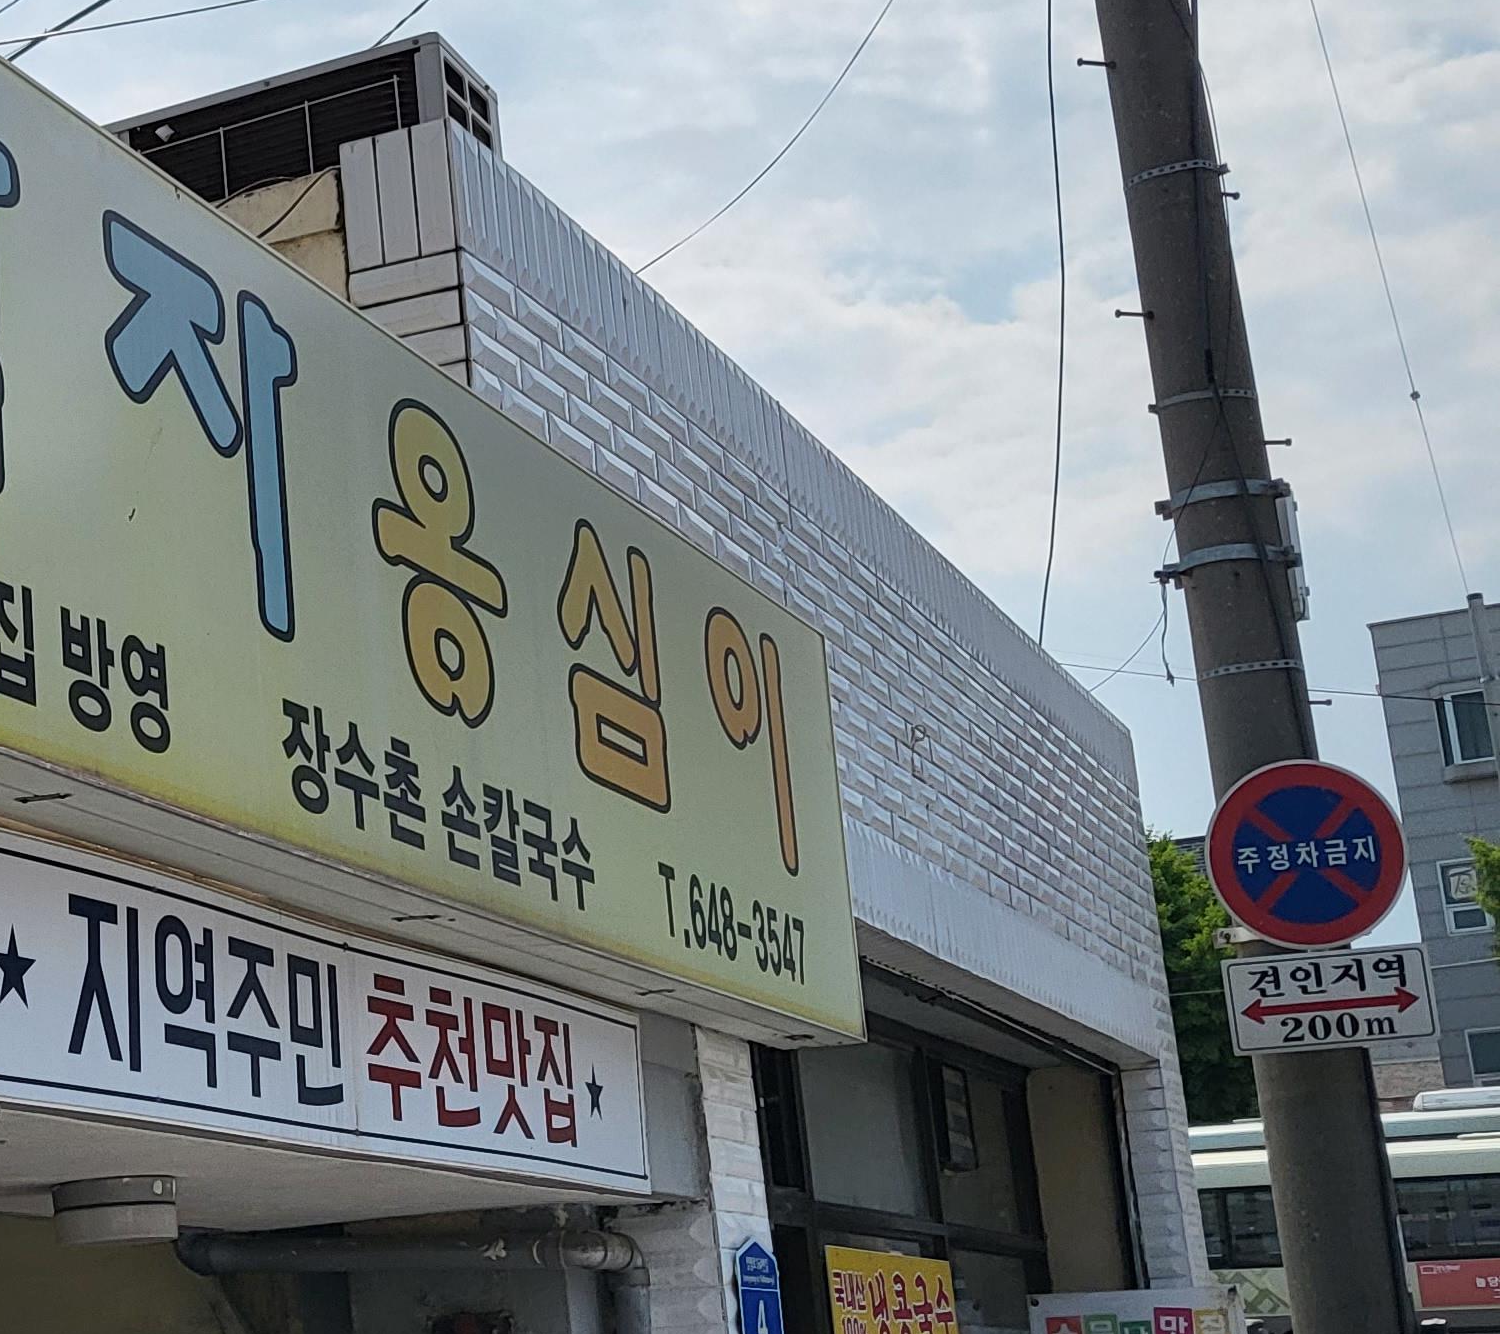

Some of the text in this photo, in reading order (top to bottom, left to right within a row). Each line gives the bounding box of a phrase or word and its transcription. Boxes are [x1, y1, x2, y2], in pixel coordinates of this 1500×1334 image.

[60, 607, 172, 755] 방영
[281, 699, 595, 911] 장수촌 손칼국수
[1237, 835, 1376, 874] 주정차금지
[658, 861, 805, 986] T.648-3547
[1248, 954, 1407, 998] 견인지역
[68, 893, 578, 1147] 지역주민 추천맛집
[1281, 1012, 1397, 1042] 200m
[832, 1270, 867, 1312] 국내산
